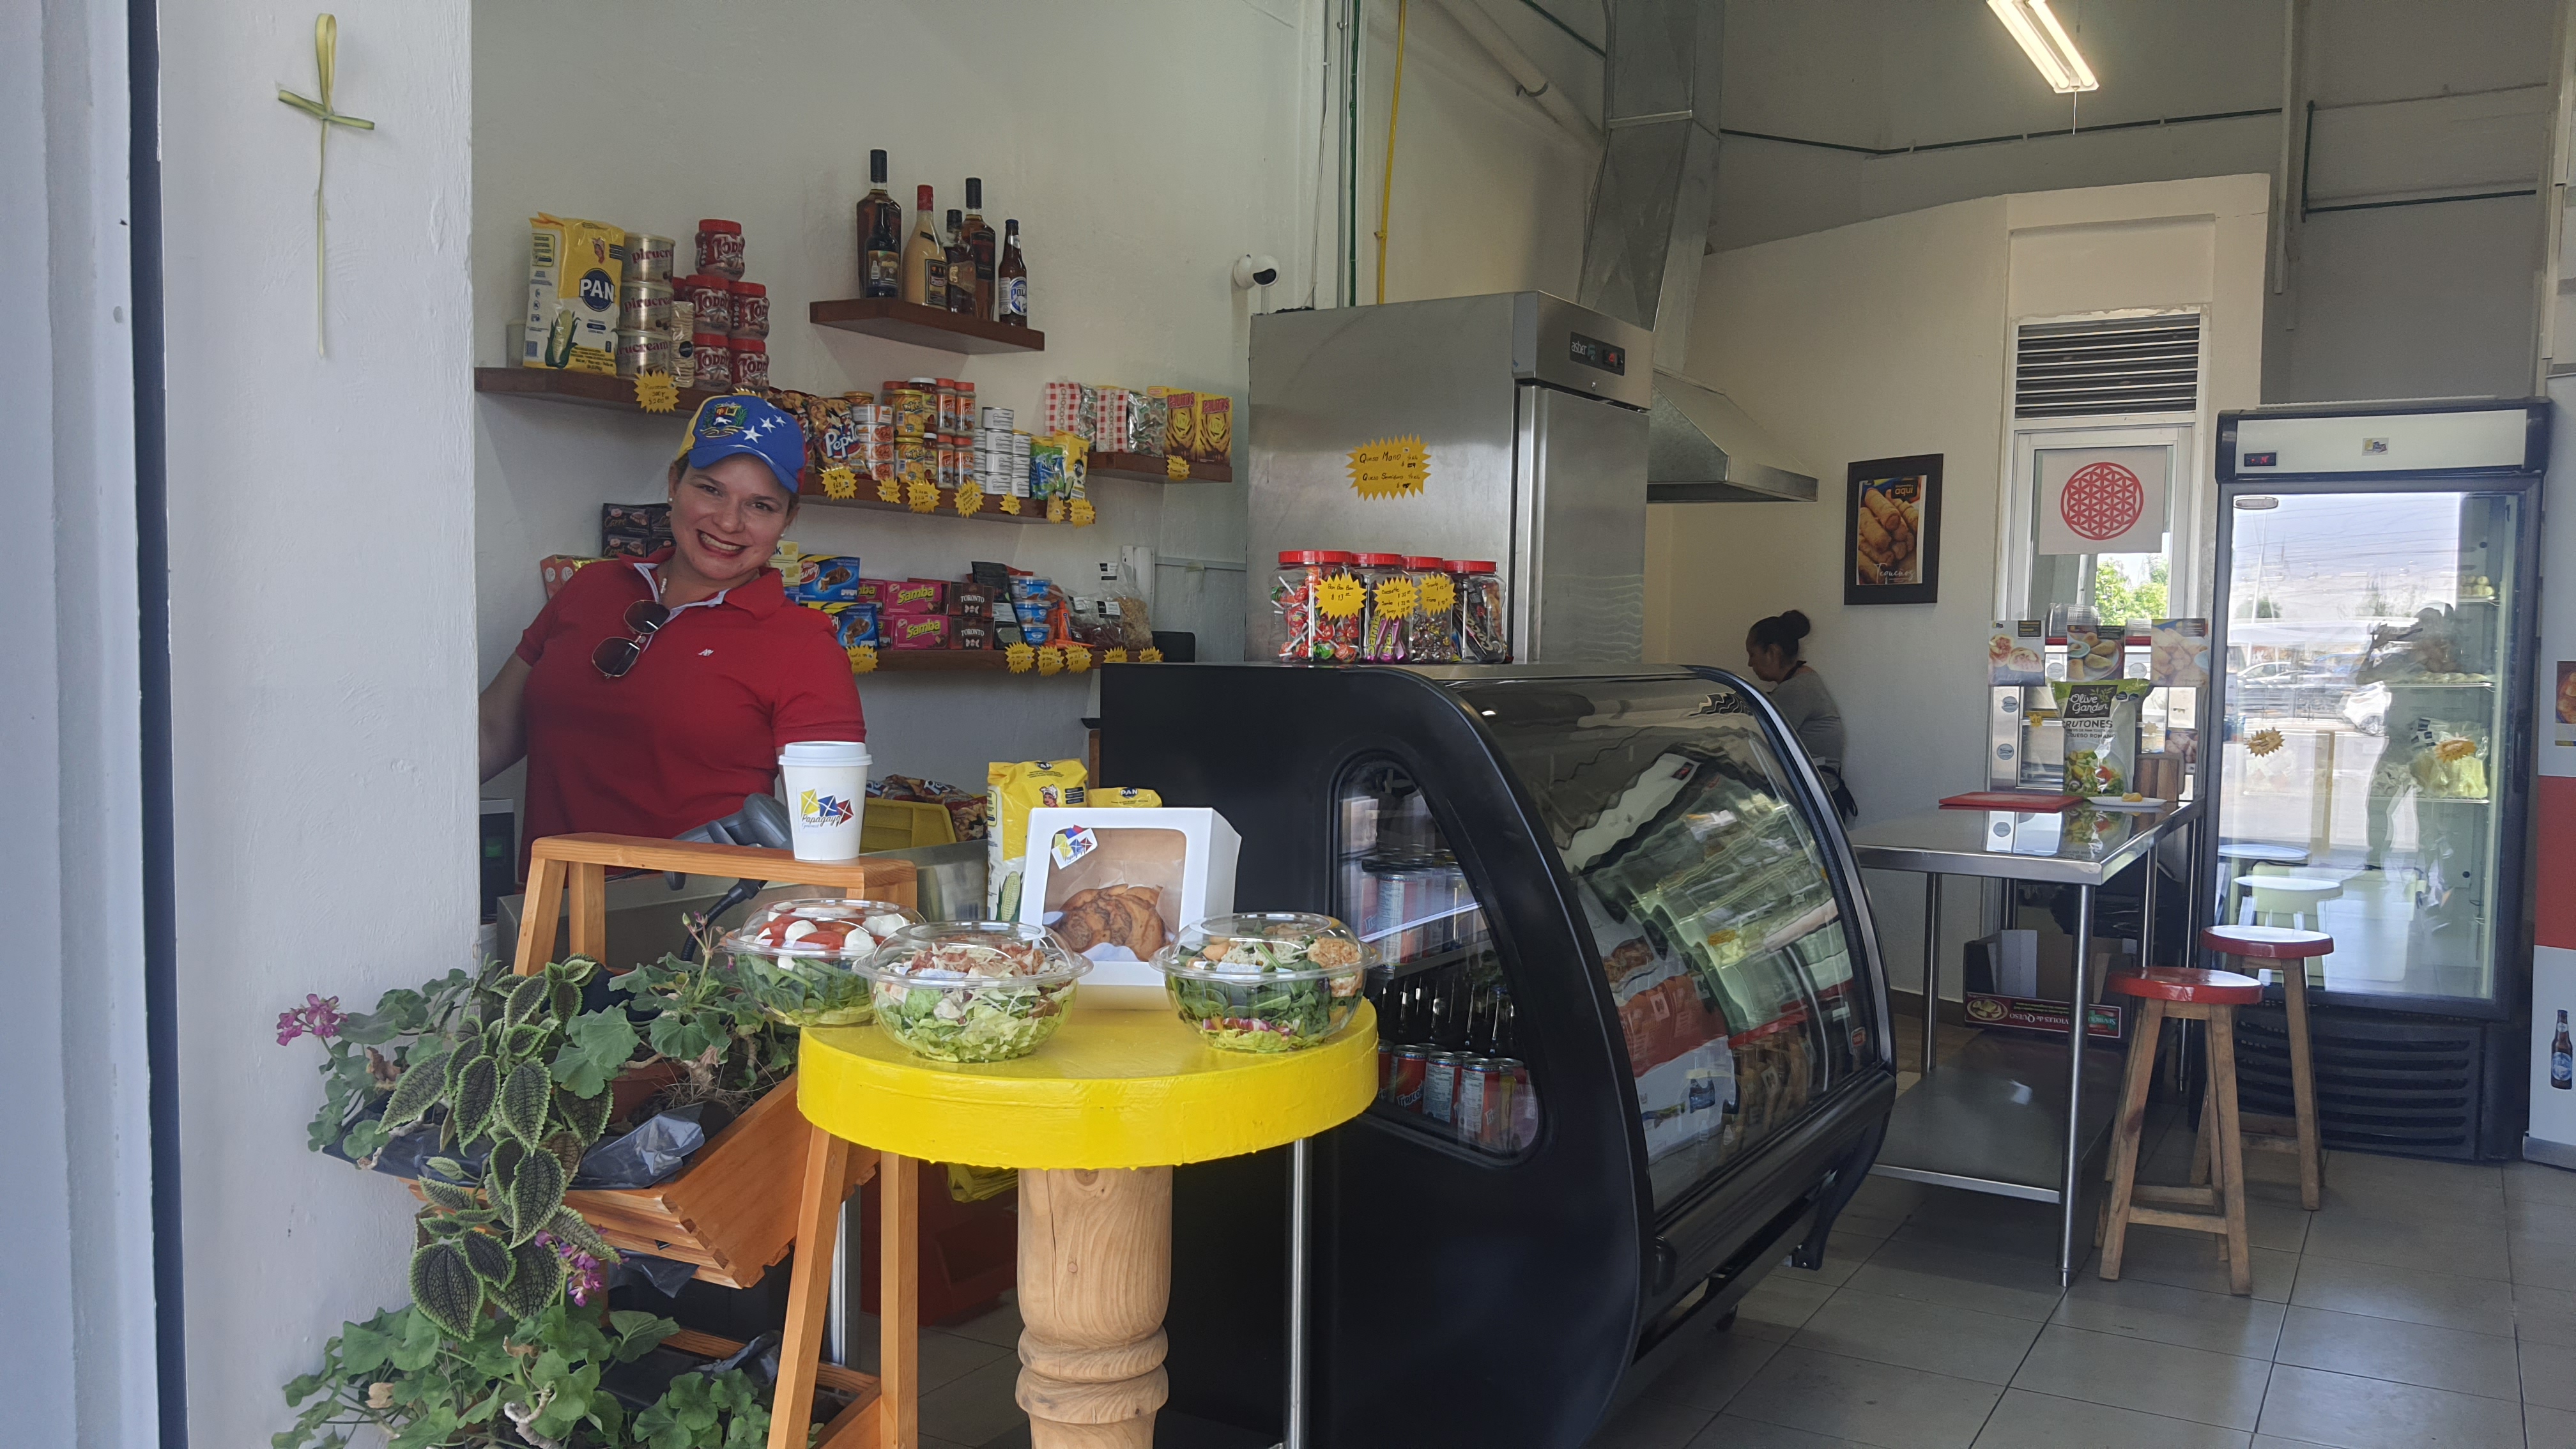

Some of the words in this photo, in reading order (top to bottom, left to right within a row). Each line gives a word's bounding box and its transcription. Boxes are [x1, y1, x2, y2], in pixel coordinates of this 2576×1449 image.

[898, 585, 935, 605] Samba
[960, 595, 985, 603] TORONTO
[907, 620, 941, 640] Samba
[961, 628, 985, 636] TORONTO
[2070, 693, 2098, 703] Olive
[2072, 703, 2108, 714] Garden
[2044, 1013, 2069, 1025] VIOLES
